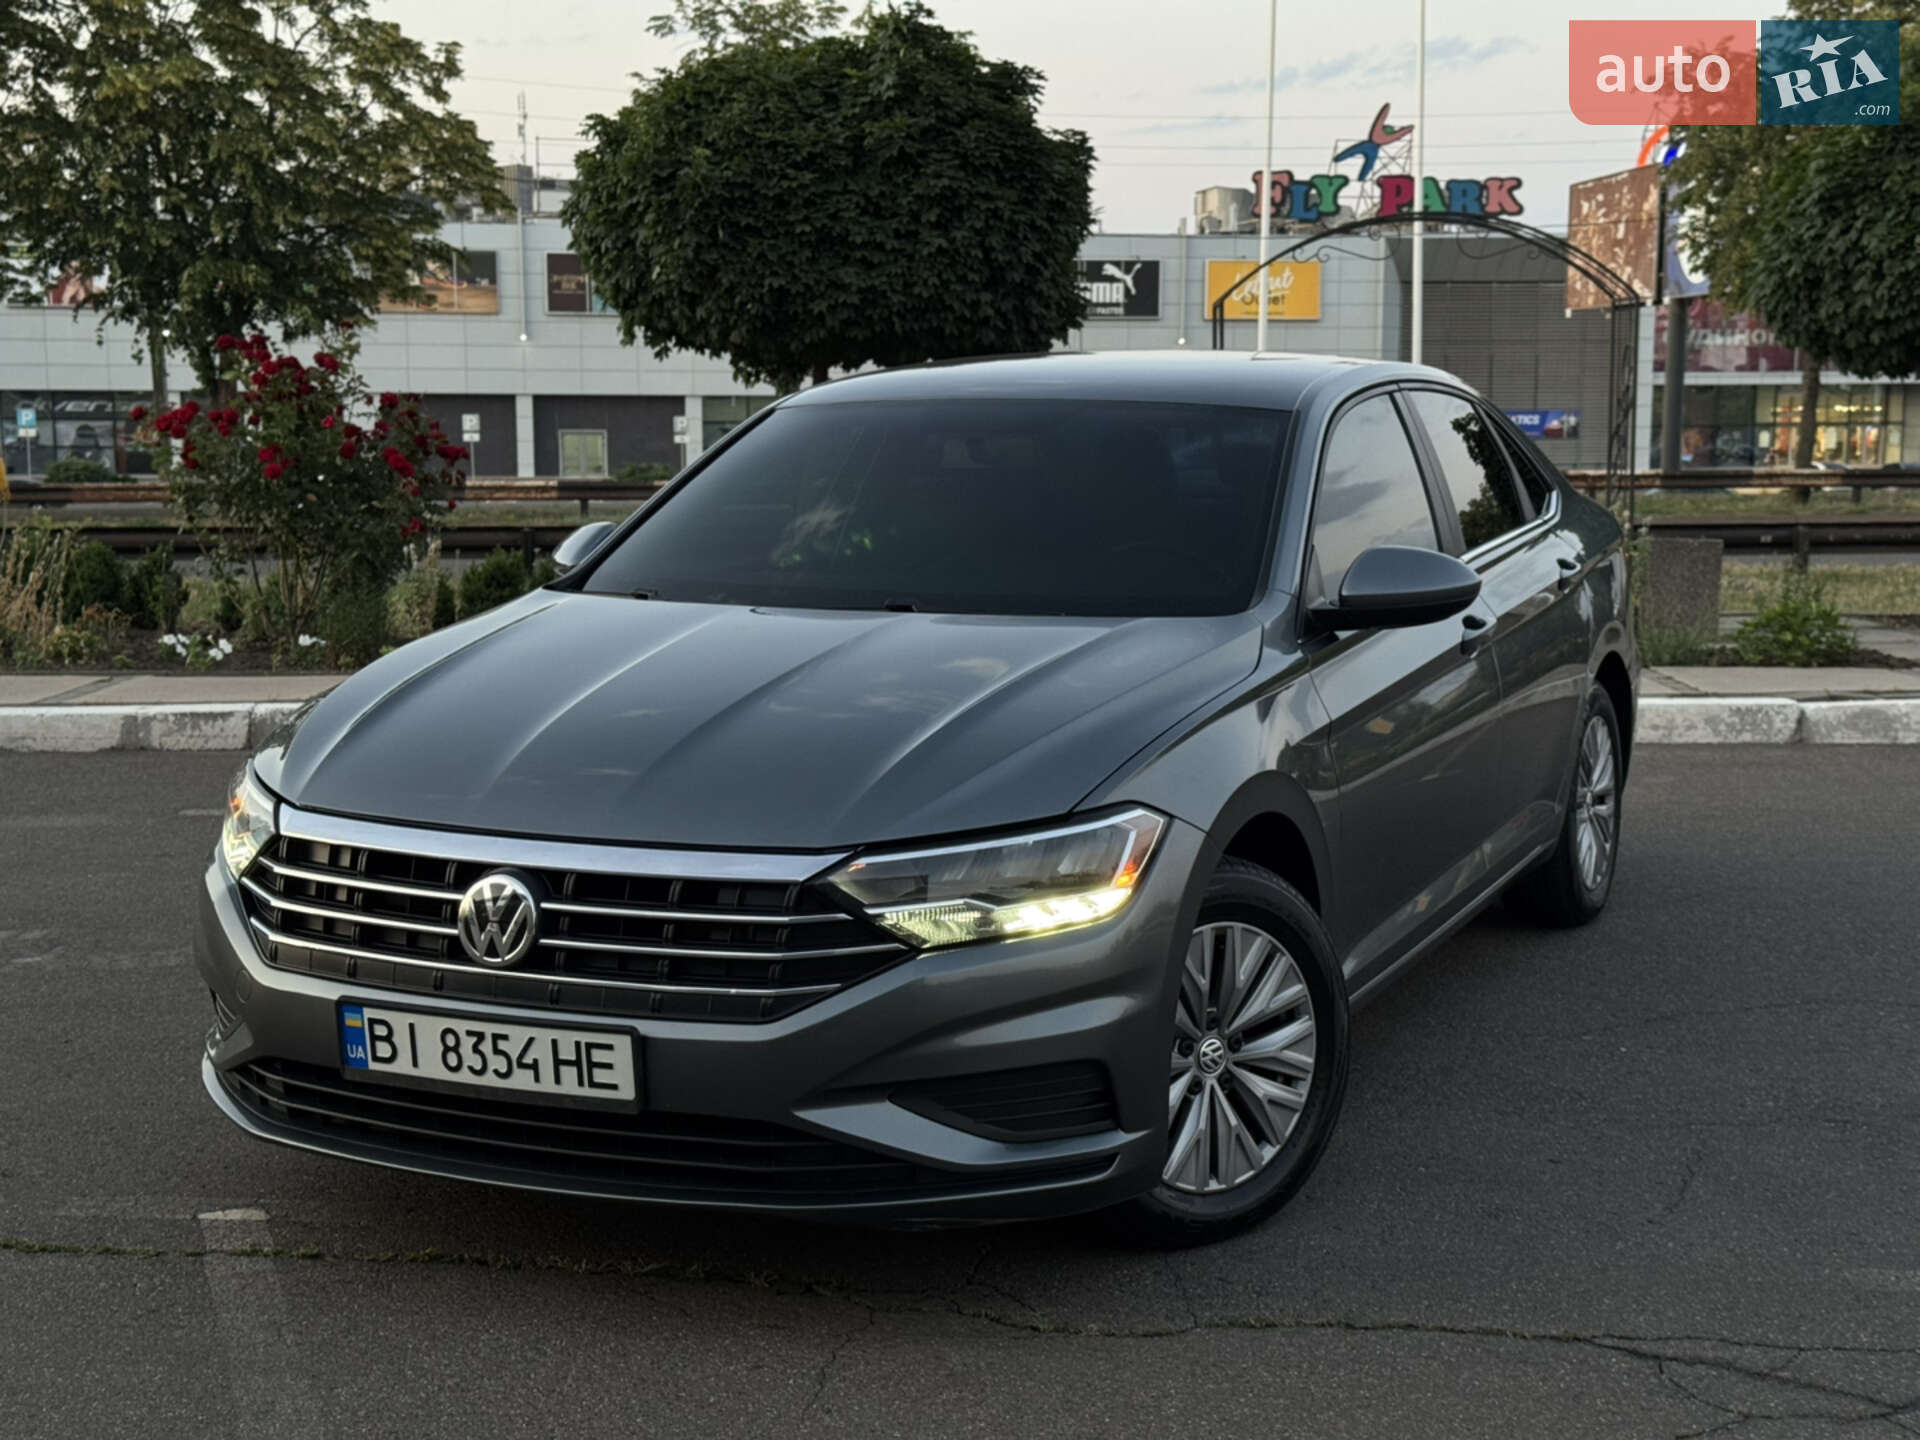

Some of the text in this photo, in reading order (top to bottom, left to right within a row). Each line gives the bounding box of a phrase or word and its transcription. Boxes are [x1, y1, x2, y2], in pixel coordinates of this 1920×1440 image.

[1253, 170, 1524, 221] FLY PARK
[1074, 282, 1124, 303] MA
[347, 1044, 366, 1060] UA
[367, 1017, 619, 1091] BI 8354 HE
